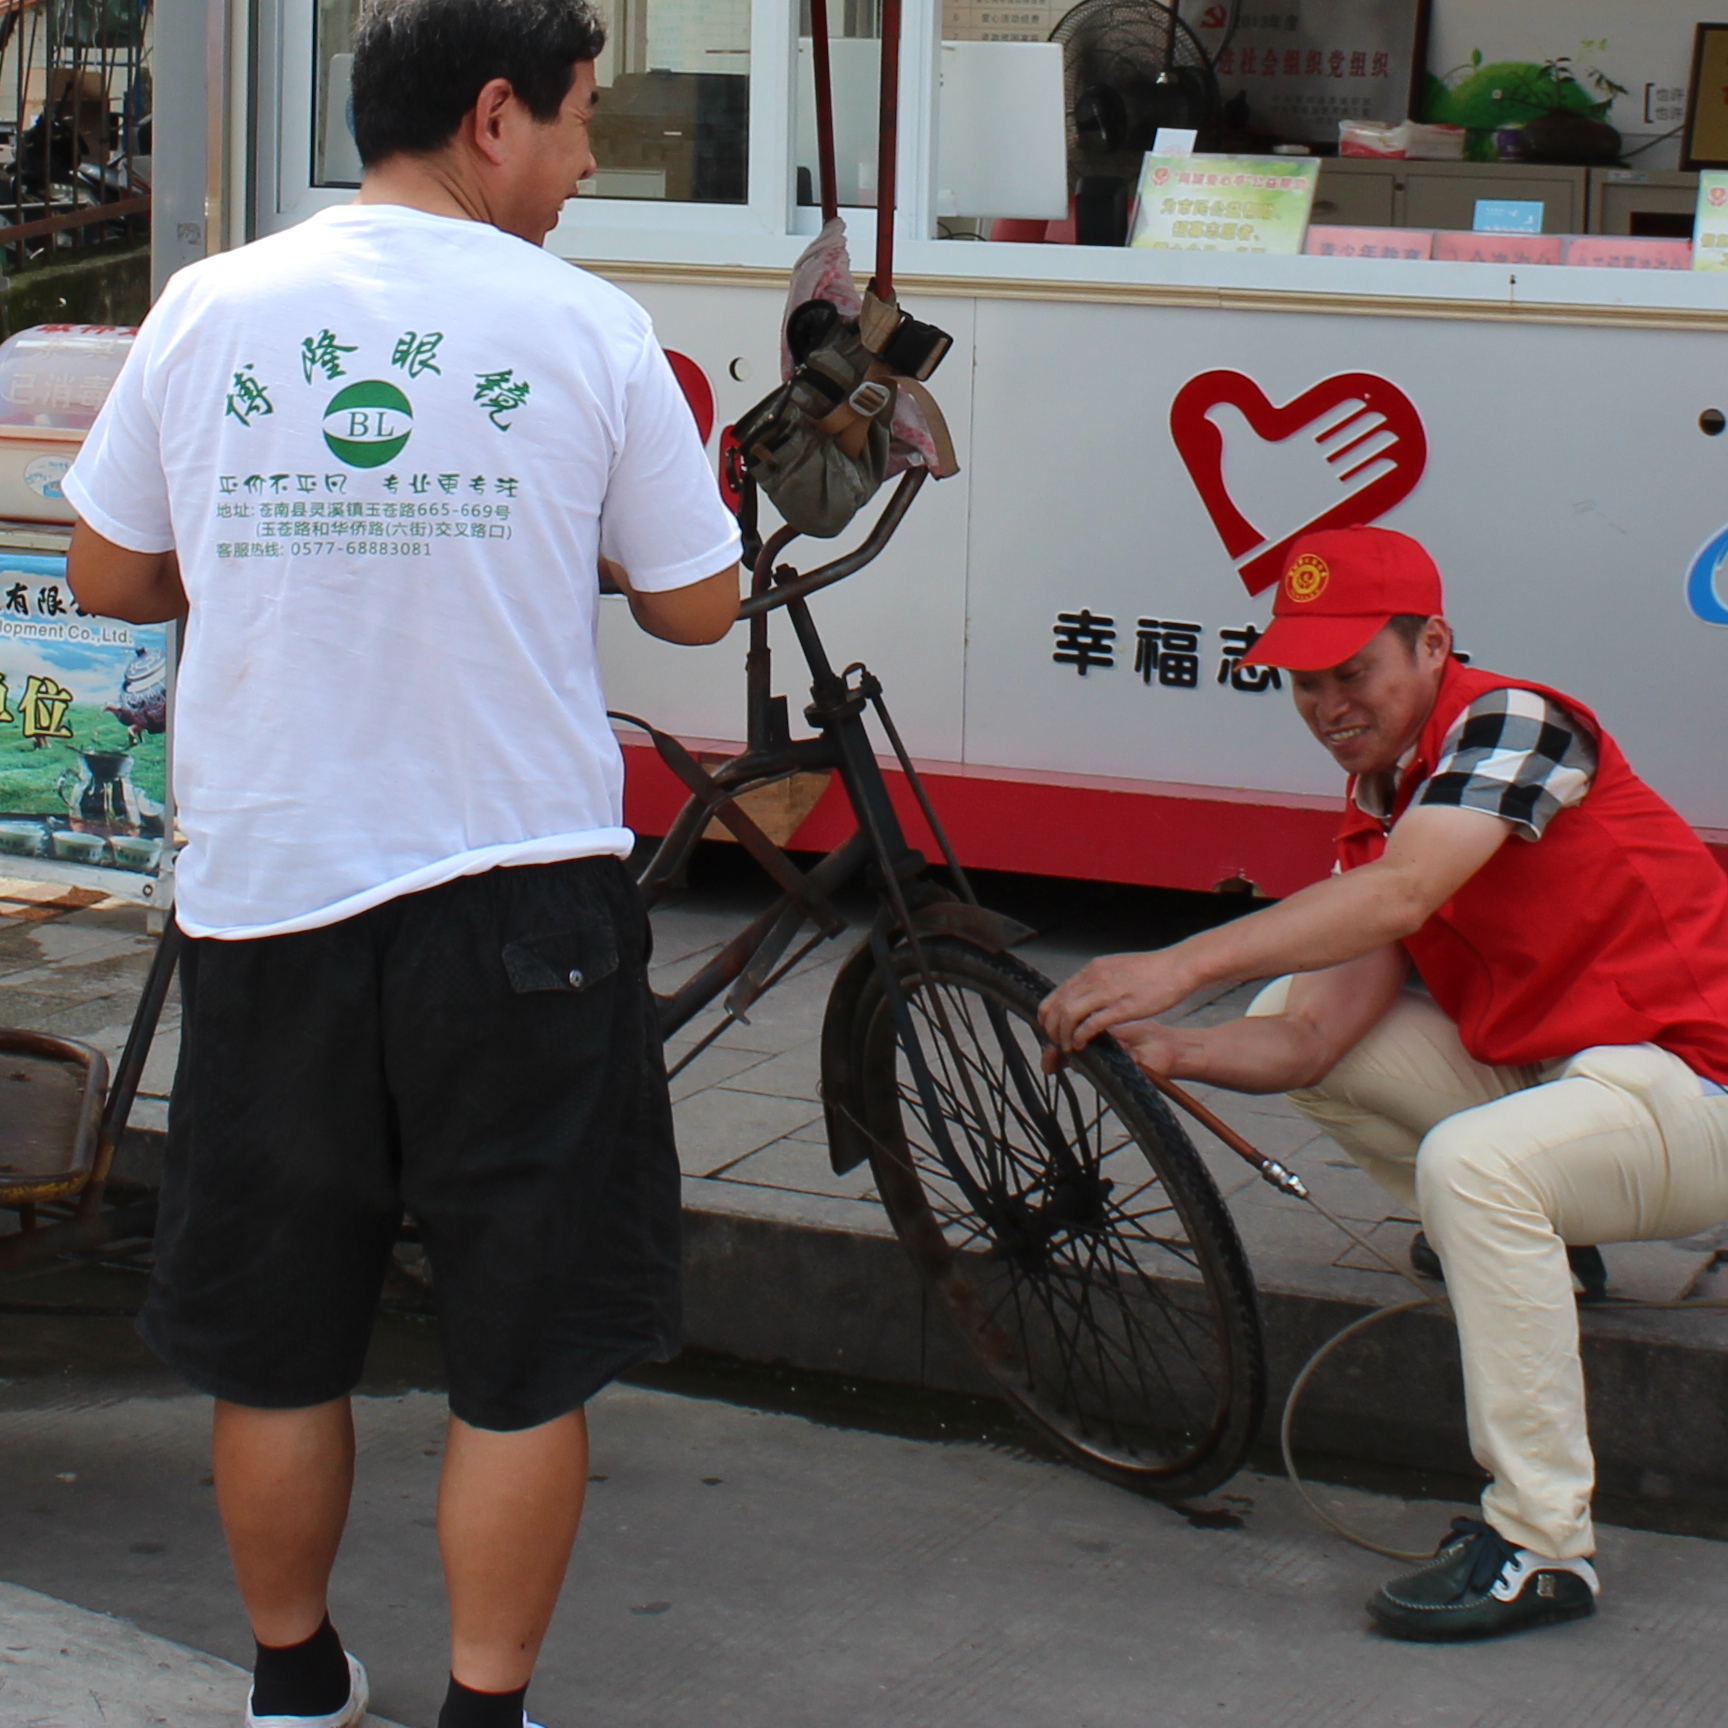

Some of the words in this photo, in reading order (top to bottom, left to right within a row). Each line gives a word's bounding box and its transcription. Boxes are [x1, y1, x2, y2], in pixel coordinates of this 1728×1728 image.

[347, 411, 396, 438] BL
[219, 473, 348, 497] 平价不平凡
[382, 473, 520, 498] 专业更专注
[216, 502, 255, 520] 地址:
[290, 540, 433, 558] 0577-68883081
